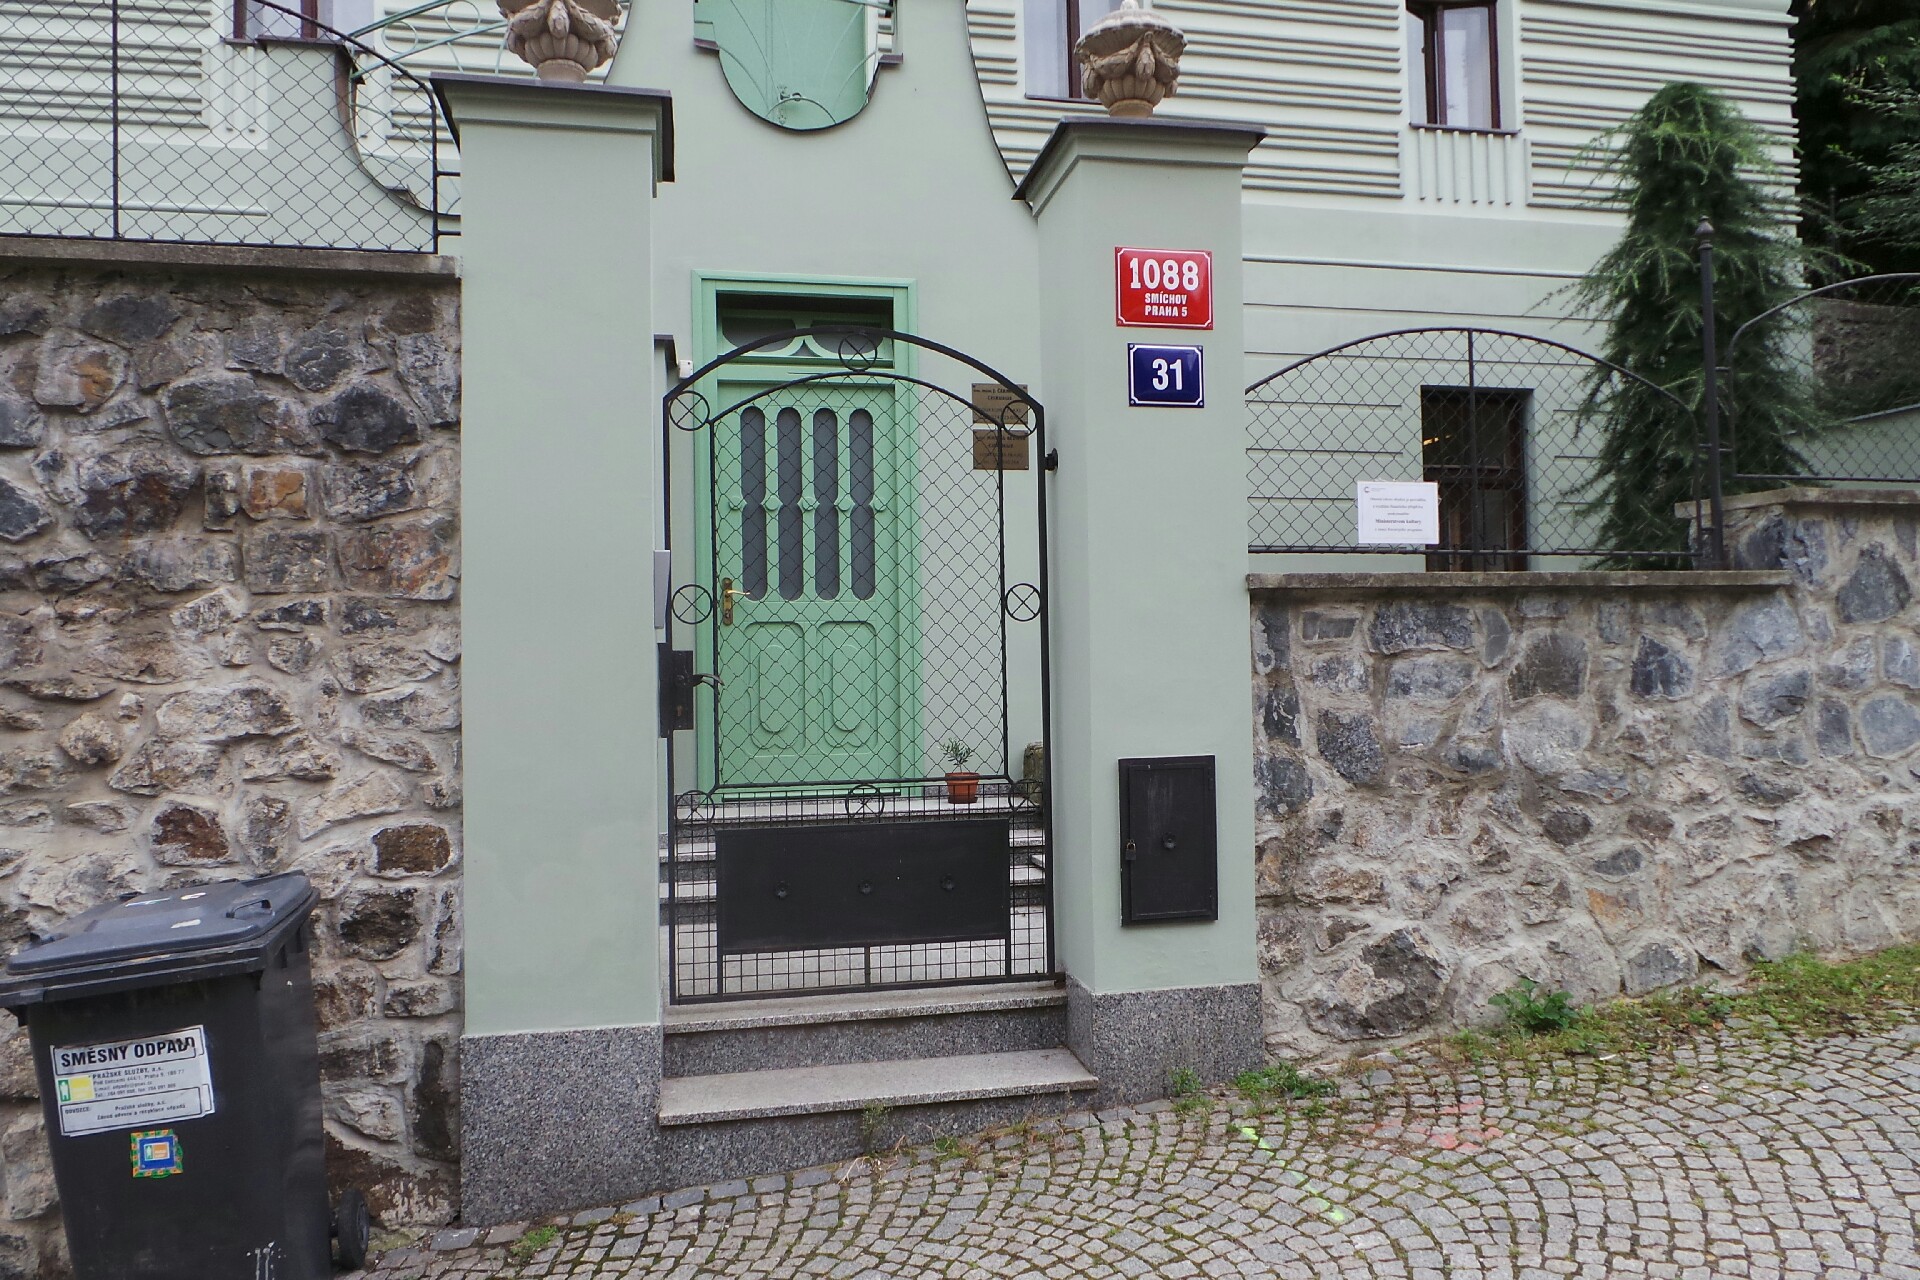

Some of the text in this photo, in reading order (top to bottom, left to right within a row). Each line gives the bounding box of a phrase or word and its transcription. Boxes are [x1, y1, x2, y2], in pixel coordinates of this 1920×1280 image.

[1130, 257, 1199, 291] 1088
[1145, 291, 1187, 305] SMÍCHOV
[1145, 305, 1188, 317] PRAHA 5
[1152, 358, 1183, 391] 31
